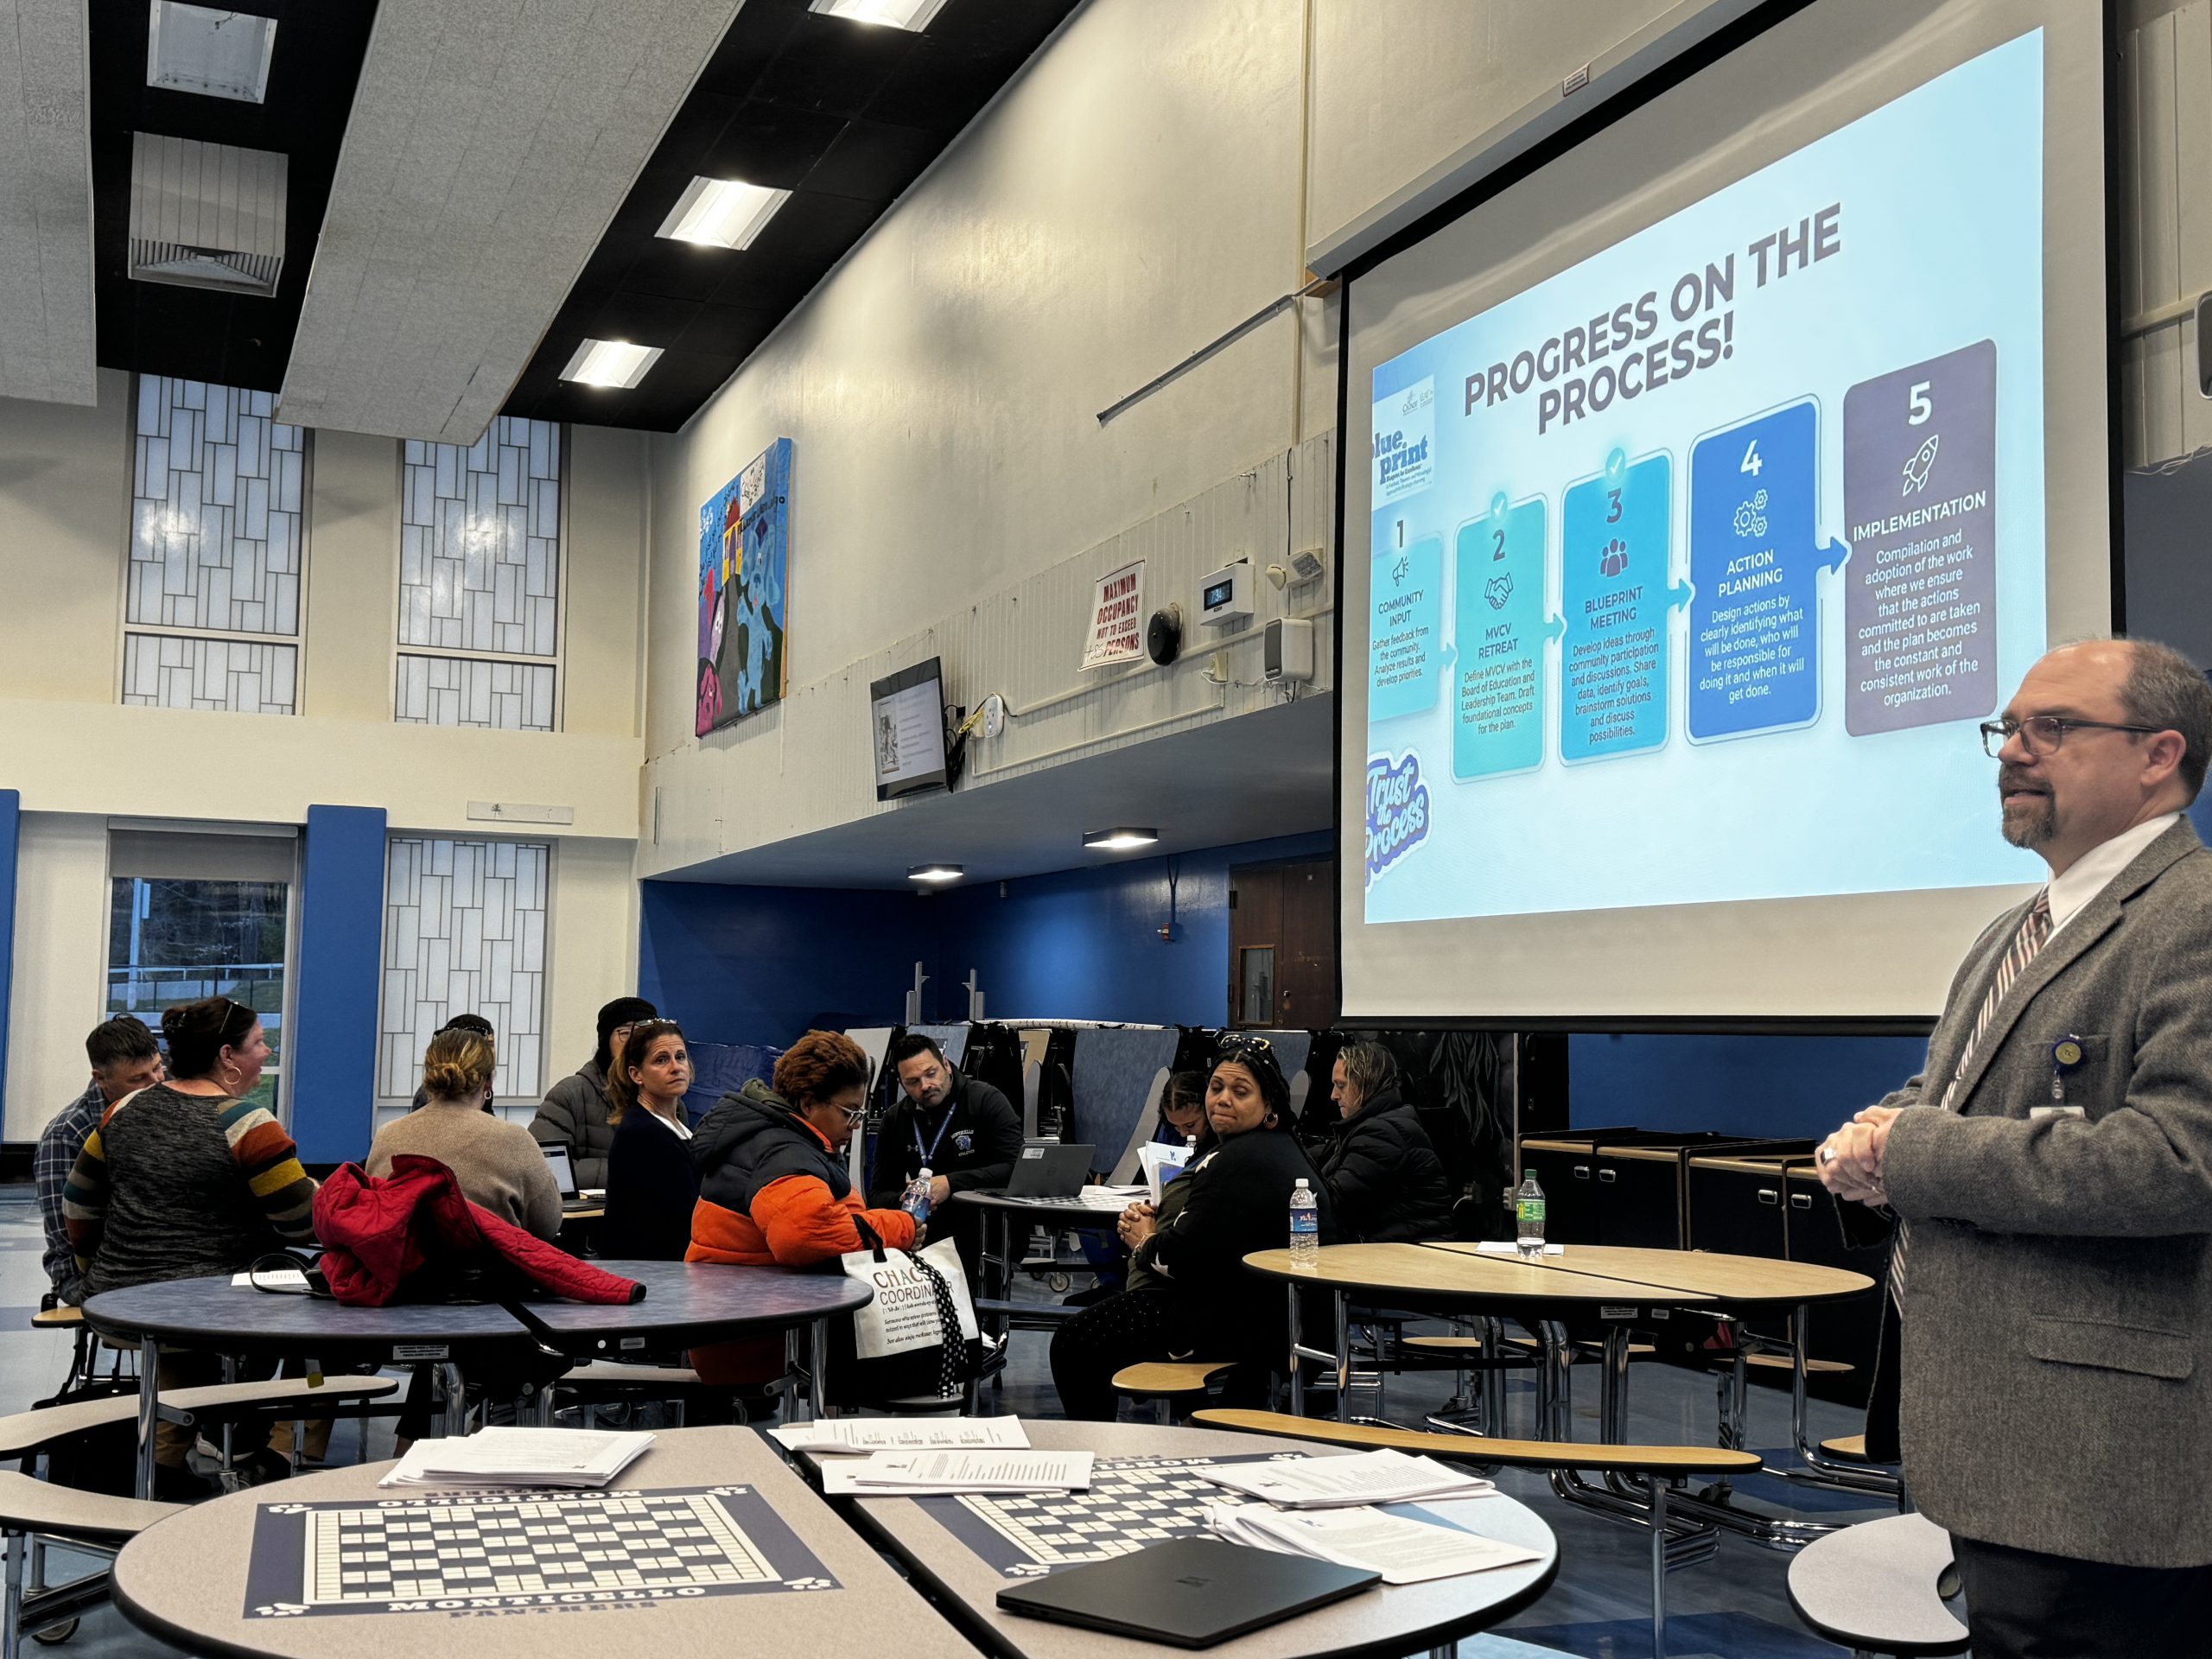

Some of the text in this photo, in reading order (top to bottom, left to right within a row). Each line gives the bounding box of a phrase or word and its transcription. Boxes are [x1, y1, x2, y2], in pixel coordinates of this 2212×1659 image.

[1465, 202, 1841, 416] PROGRESS ON THE
[1539, 309, 1734, 435] PROCESS!
[1908, 380, 1933, 426] 5
[1379, 435, 1428, 485] print
[1740, 439, 1763, 476] 4
[1605, 487, 1623, 524] 3
[1853, 490, 1986, 543] IMPLEMENTATION
[1396, 519, 1404, 548] 1
[1492, 529, 1506, 562] 2
[1876, 528, 1962, 564] Compilation and
[1726, 549, 1774, 575] ACTION
[1866, 545, 1974, 585] adoption of the work
[1103, 573, 1136, 603] MAXIMUM
[1718, 568, 1783, 598] PLANNING
[1875, 569, 1964, 601] where we ensure
[1096, 594, 1139, 626] OCCUPANCY
[1378, 589, 1424, 615] COMMUNITY
[1585, 586, 1643, 614] BLUEPRINT
[1712, 594, 1790, 623] Design actions by
[1878, 588, 1960, 618] that the actions
[1096, 617, 1136, 639] NOT TO EXCEED
[1389, 609, 1412, 627] INPUT
[1485, 622, 1512, 640] MVCV
[1590, 607, 1637, 631] MEETING
[1700, 607, 1804, 642] clearly identifying what
[1859, 602, 1980, 639] committed to are taken
[1103, 632, 1140, 657] PERSONS
[1372, 626, 1429, 651] Gather feedback from
[1478, 638, 1519, 659] RETREAT
[1573, 626, 1655, 658] Develop ideas through
[1704, 624, 1799, 657] will be done, who will
[1861, 621, 1978, 657] and the plan becomes
[1374, 652, 1427, 676] Analyze results and
[1380, 650, 1389, 661] the
[1568, 643, 1659, 673] community participation
[1711, 645, 1792, 672] be responsible for
[1874, 640, 1962, 672] the constant and
[1376, 674, 1398, 688] develop
[1461, 670, 1535, 697] Board of Education and
[1465, 658, 1533, 683] Define MVCV with the
[1571, 659, 1656, 687] and discussions. Share
[1700, 658, 1805, 690] doing it and when it will
[1860, 658, 1979, 692] consistent work of the
[1461, 684, 1535, 712] Leadership Team. Draft
[1577, 677, 1649, 701] data, identify goals,
[1729, 684, 1771, 704] get done.
[1884, 683, 1952, 708] organization.
[1462, 701, 1534, 724] foundational concepts
[1575, 691, 1651, 716] brainstorm solutions
[1478, 719, 1516, 734] for the plan.
[1590, 709, 1635, 728] and discuss
[1589, 725, 1636, 745] possibilities.
[1368, 762, 1414, 814] Trust
[1376, 803, 1392, 826] the
[1092, 1459, 1215, 1470] MONTI
[378, 1490, 643, 1509] MONTICELLO
[388, 1586, 706, 1611] MONTICELLO
[448, 1601, 658, 1618] PANTHERS
